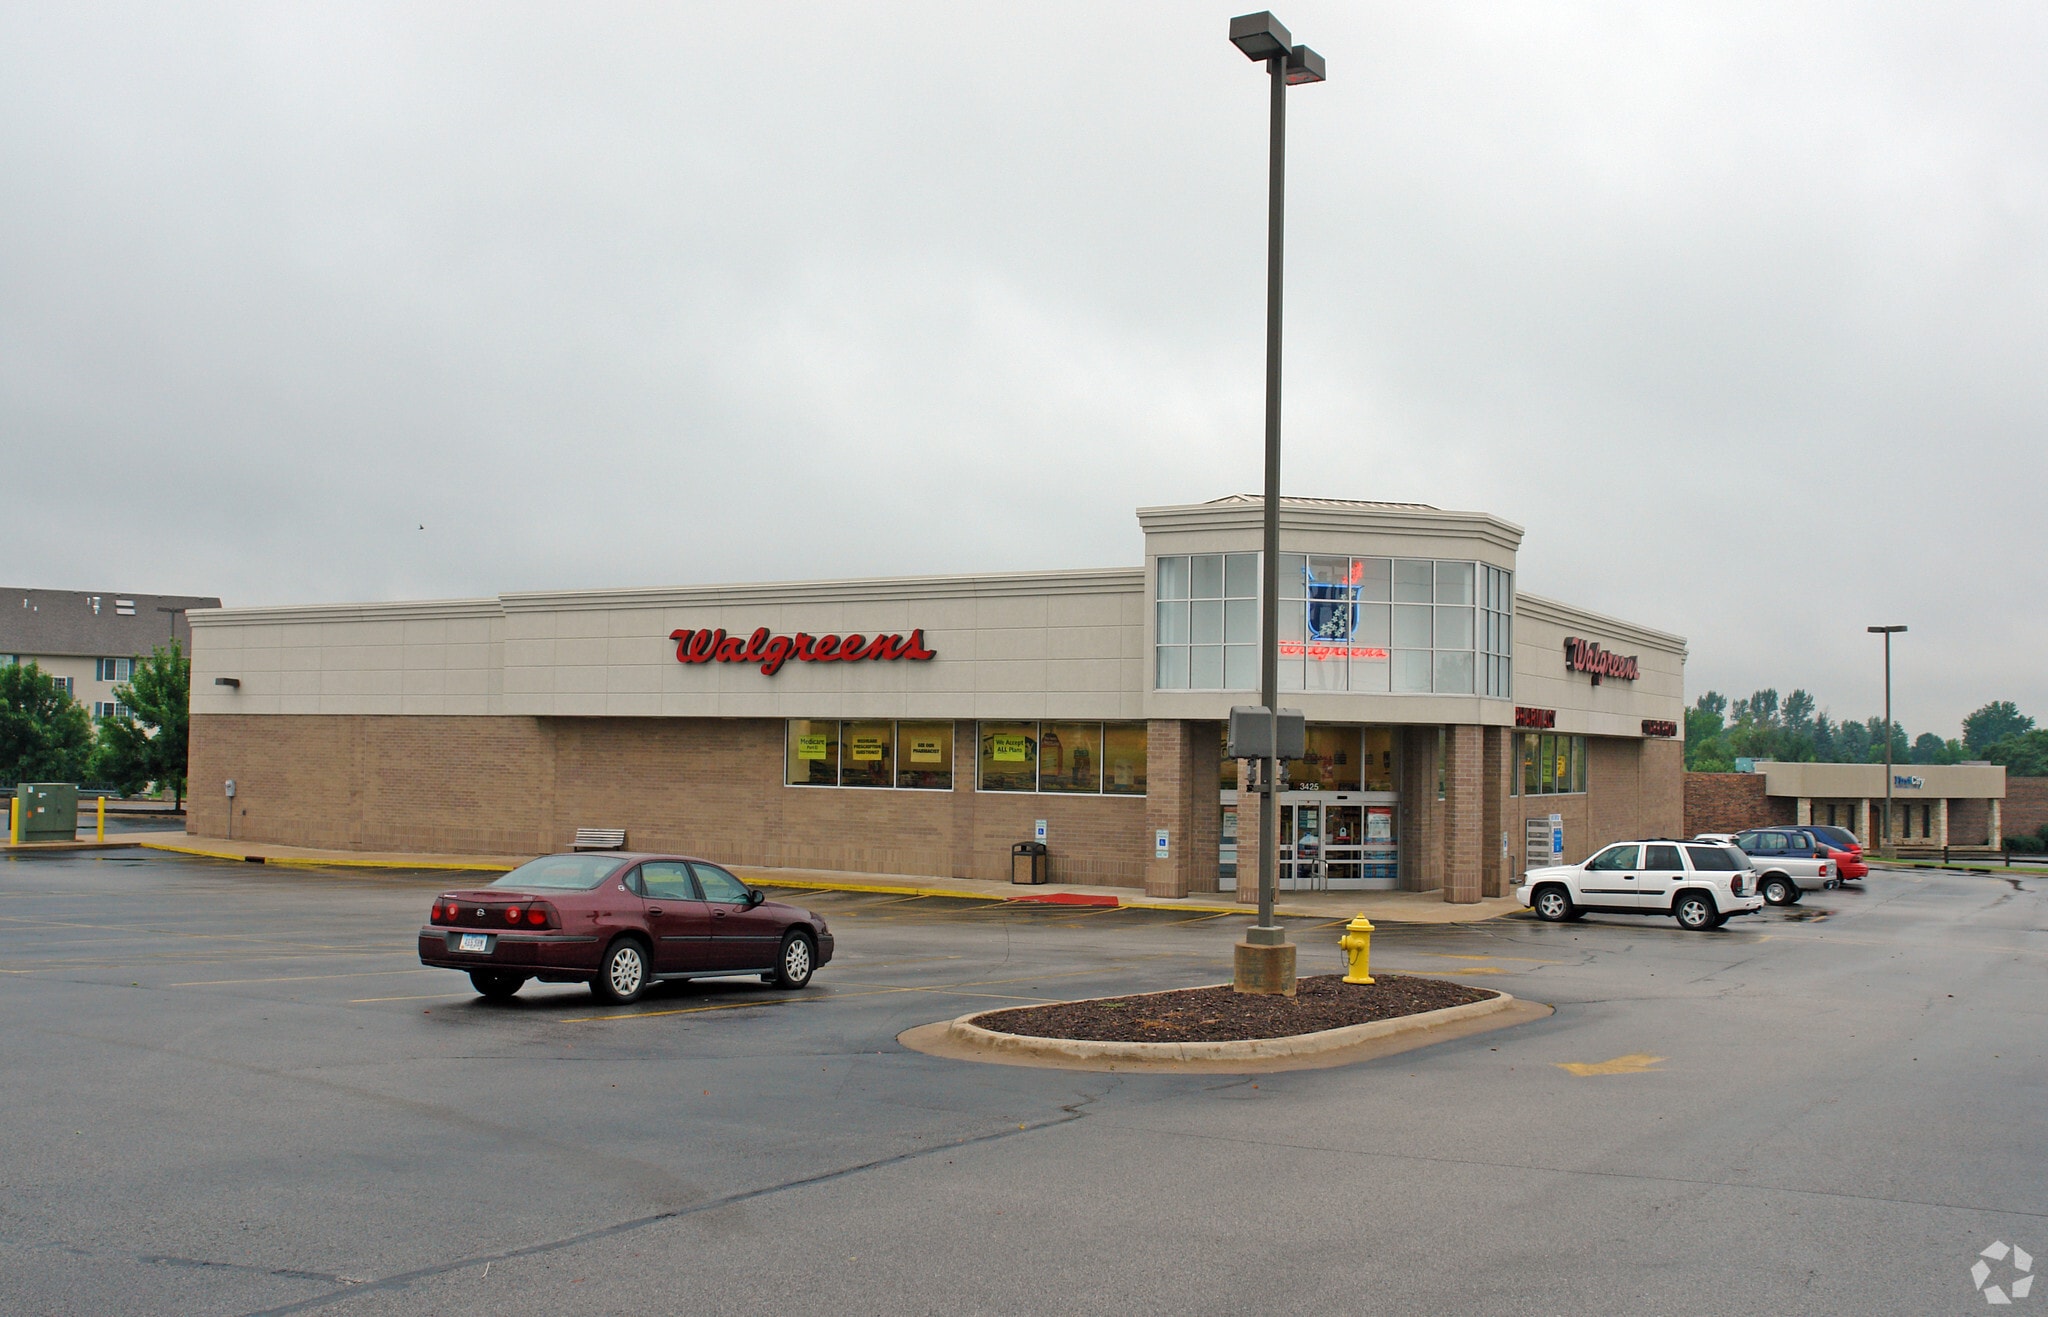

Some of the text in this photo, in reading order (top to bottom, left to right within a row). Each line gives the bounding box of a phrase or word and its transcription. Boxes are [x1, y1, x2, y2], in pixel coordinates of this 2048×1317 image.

[669, 627, 937, 676] Walgreens
[1563, 636, 1640, 686] Walgreens
[1005, 739, 1024, 747] Accept
[1299, 782, 1319, 791] 3425
